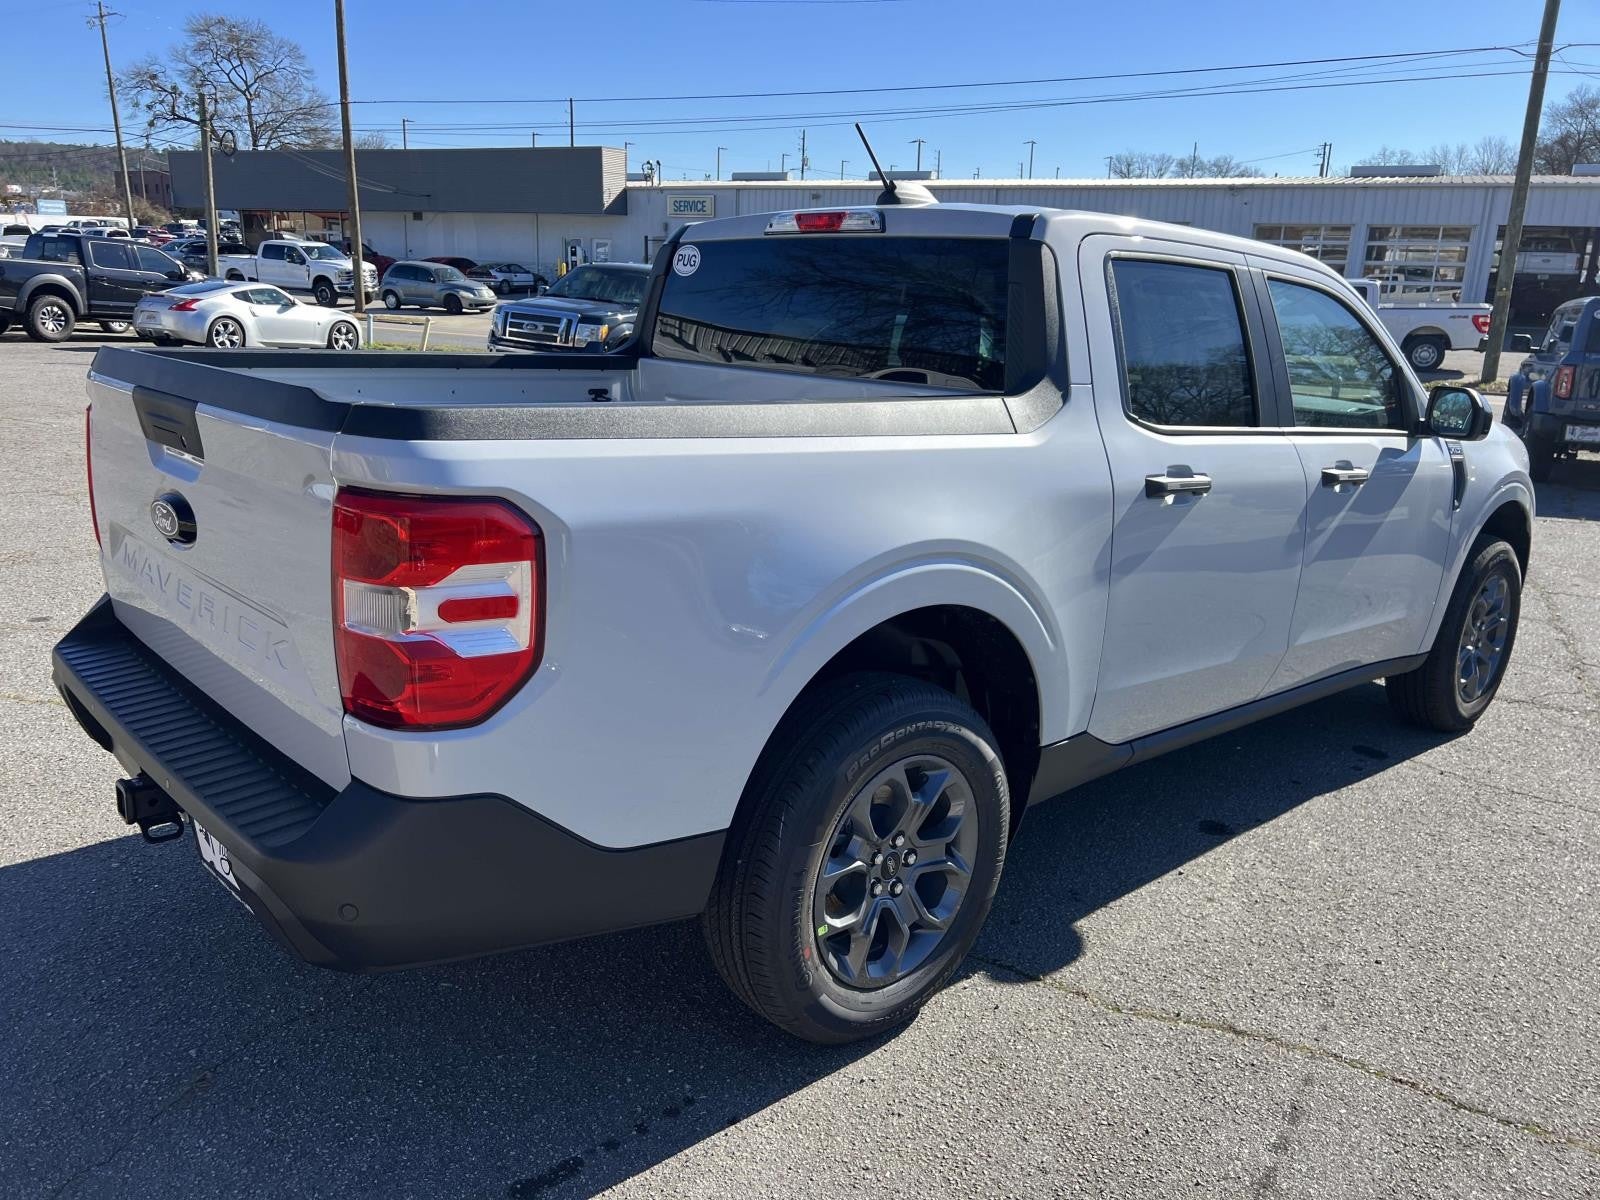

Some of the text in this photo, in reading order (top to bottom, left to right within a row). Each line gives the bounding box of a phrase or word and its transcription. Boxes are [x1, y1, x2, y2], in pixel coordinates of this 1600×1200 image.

[673, 200, 707, 213] SERVICE
[676, 253, 697, 267] PUG
[154, 504, 172, 532] Ford
[123, 542, 289, 671] MAVERICK
